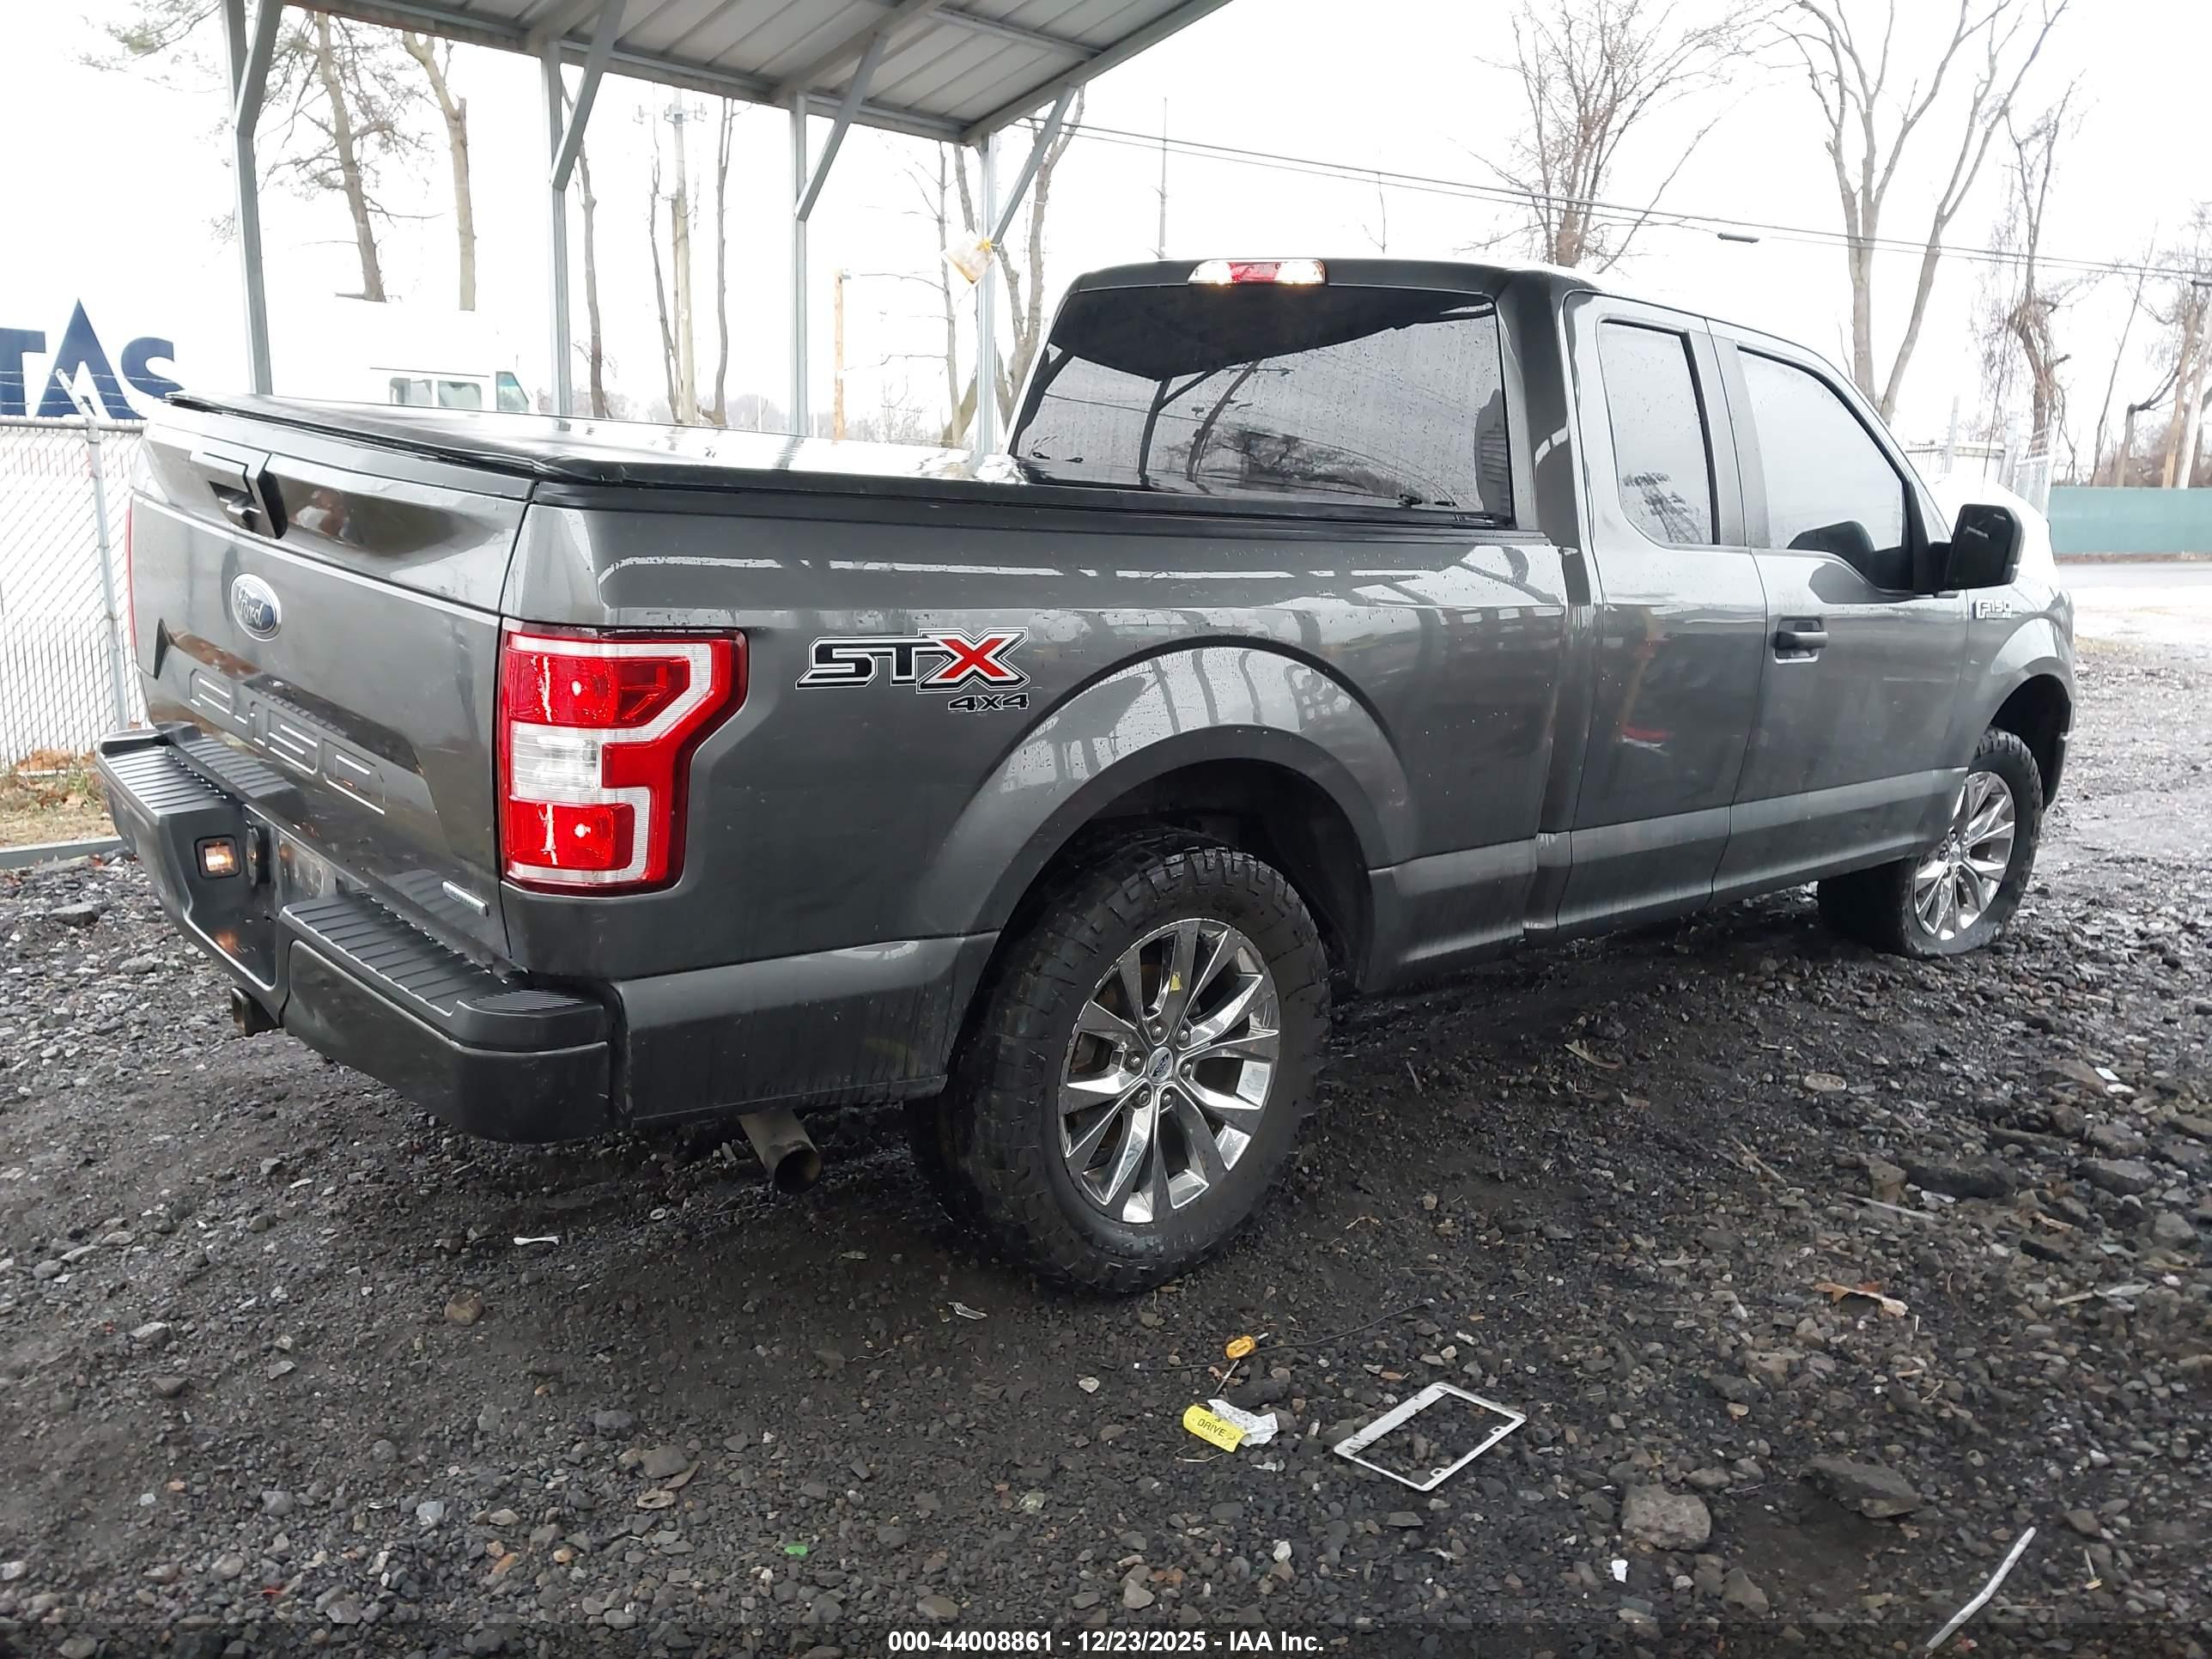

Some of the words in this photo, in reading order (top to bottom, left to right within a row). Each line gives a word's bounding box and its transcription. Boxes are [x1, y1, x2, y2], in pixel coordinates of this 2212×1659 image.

[236, 582, 264, 626] Ford
[795, 626, 1030, 694] STX
[1196, 1418, 1228, 1437] DRIVE
